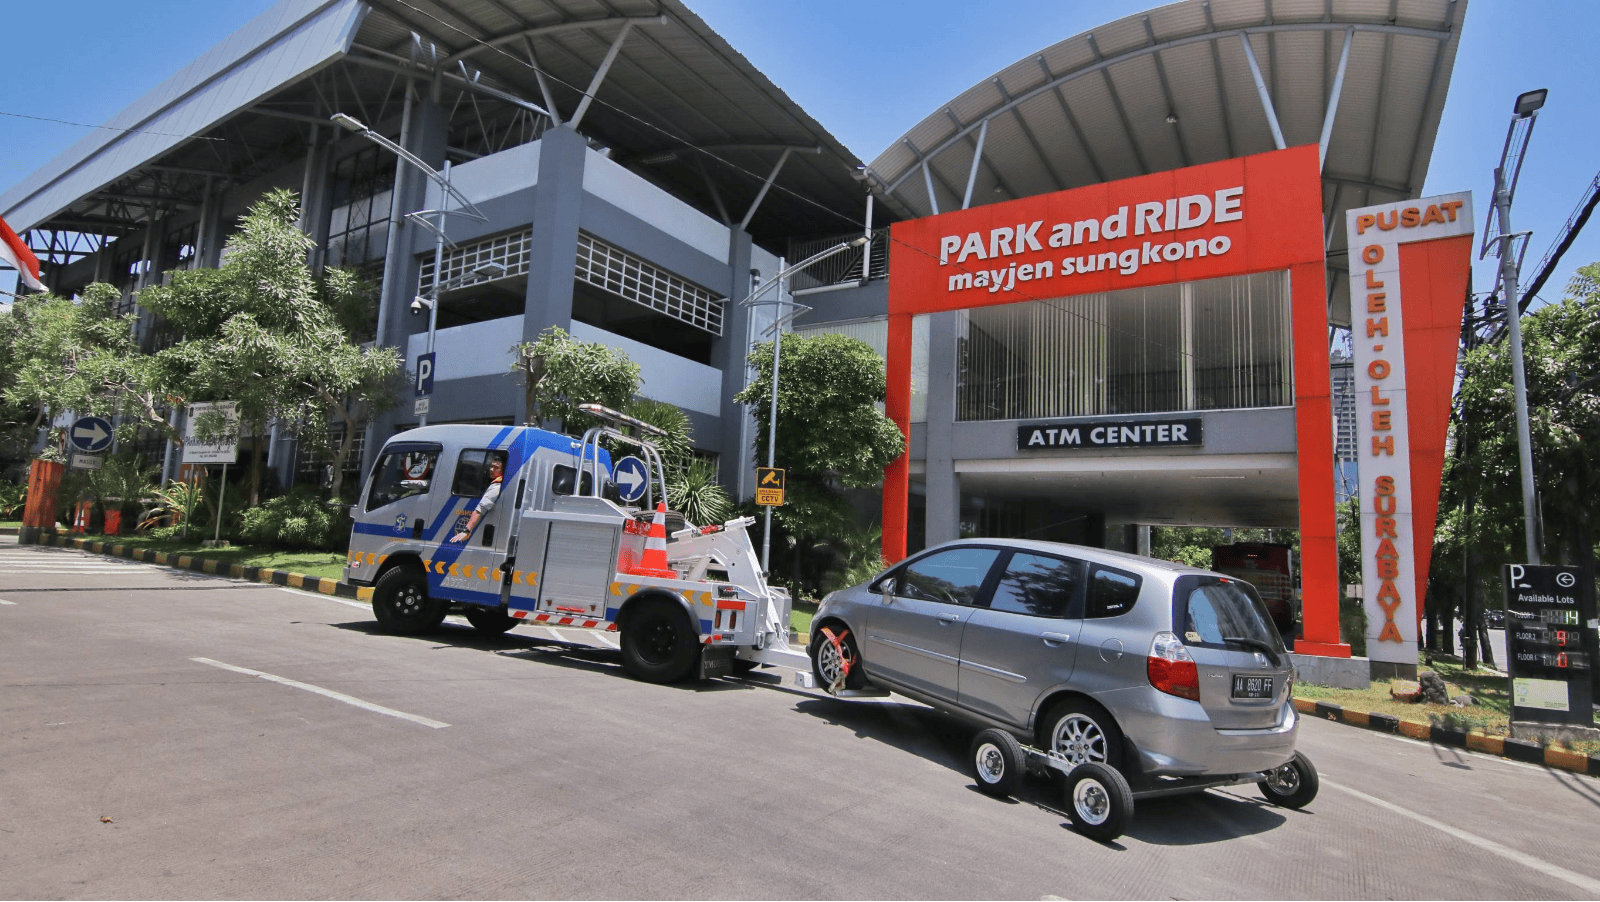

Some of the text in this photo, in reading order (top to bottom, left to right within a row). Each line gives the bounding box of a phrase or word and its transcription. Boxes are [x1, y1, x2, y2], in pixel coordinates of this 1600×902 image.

[938, 185, 1244, 266] PARK and RIDE
[1356, 200, 1463, 235] PUSAT
[948, 235, 1232, 293] mayjen sungkono
[418, 359, 432, 391] P
[1027, 423, 1189, 446] ATM CENTER
[1361, 243, 1403, 644] OLEH-OLEH SURABAYA
[761, 495, 779, 503] CCTV
[1518, 593, 1575, 604] Available Lots
[1516, 632, 1532, 640] FLOOR
[1517, 653, 1534, 661] FLOOR
[1247, 678, 1262, 691] 8620
[1263, 678, 1272, 692] FF
